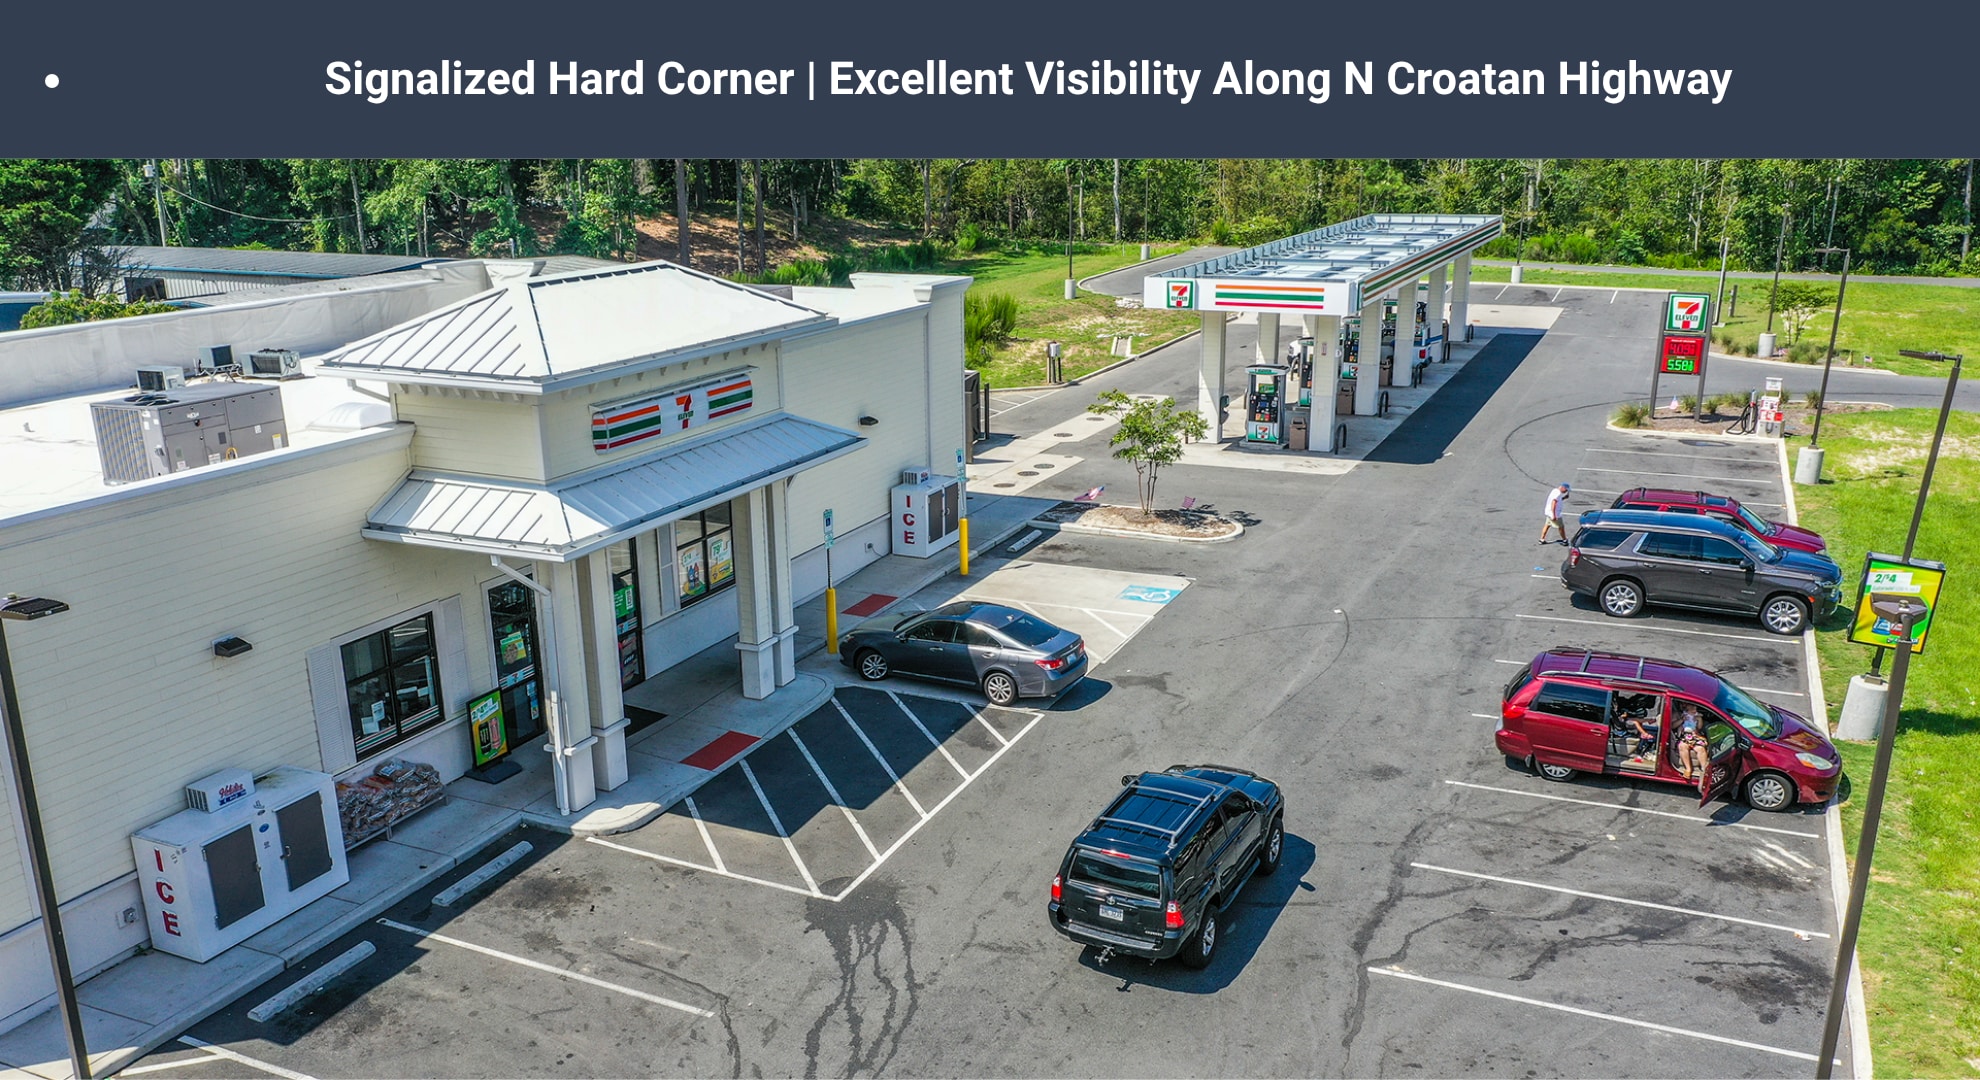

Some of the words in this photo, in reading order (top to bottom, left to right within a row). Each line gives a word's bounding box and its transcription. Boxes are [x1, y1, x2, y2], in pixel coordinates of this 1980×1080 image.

[1172, 285, 1187, 307] 7
[1678, 301, 1699, 329] 7
[675, 394, 692, 430] 7
[902, 495, 916, 545] ICE
[154, 847, 182, 937] ICE
